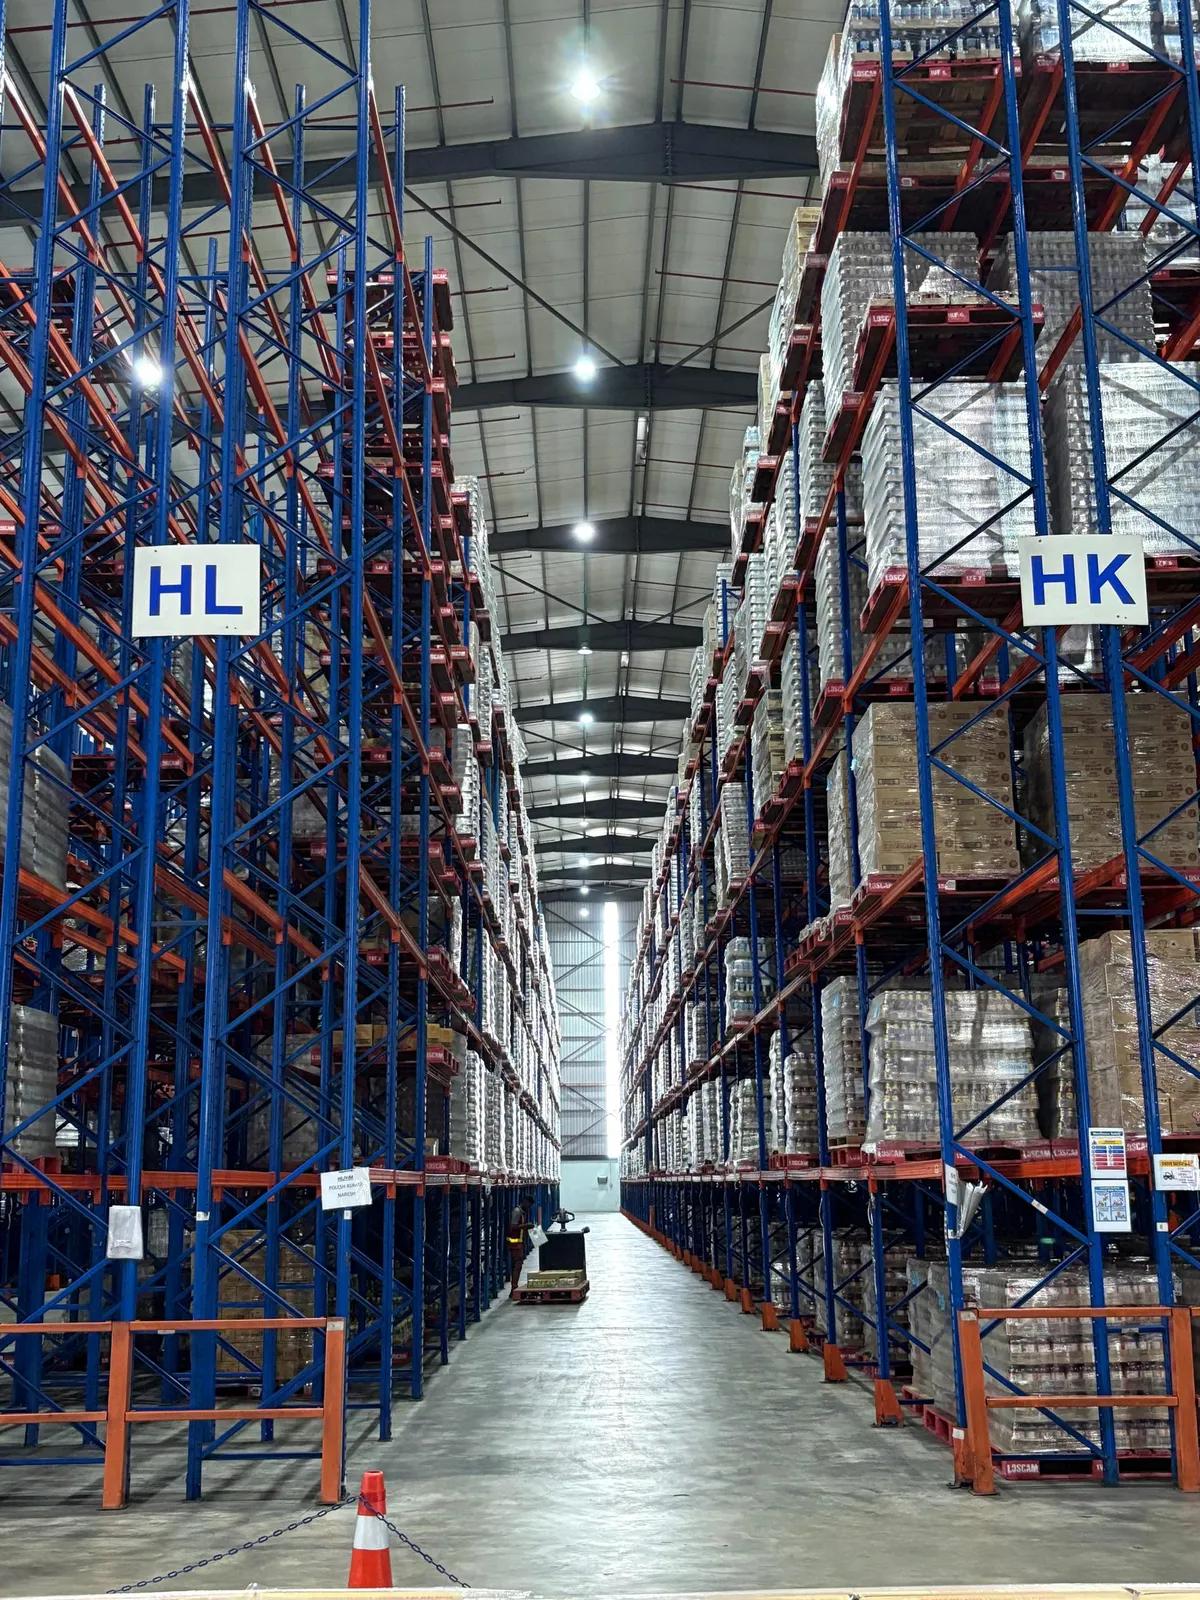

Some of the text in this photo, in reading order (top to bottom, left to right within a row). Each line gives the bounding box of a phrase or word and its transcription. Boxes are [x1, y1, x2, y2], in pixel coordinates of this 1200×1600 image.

[148, 564, 244, 616] HL
[1031, 553, 1136, 606] HK
[1007, 1463, 1039, 1473] LOSCAM
